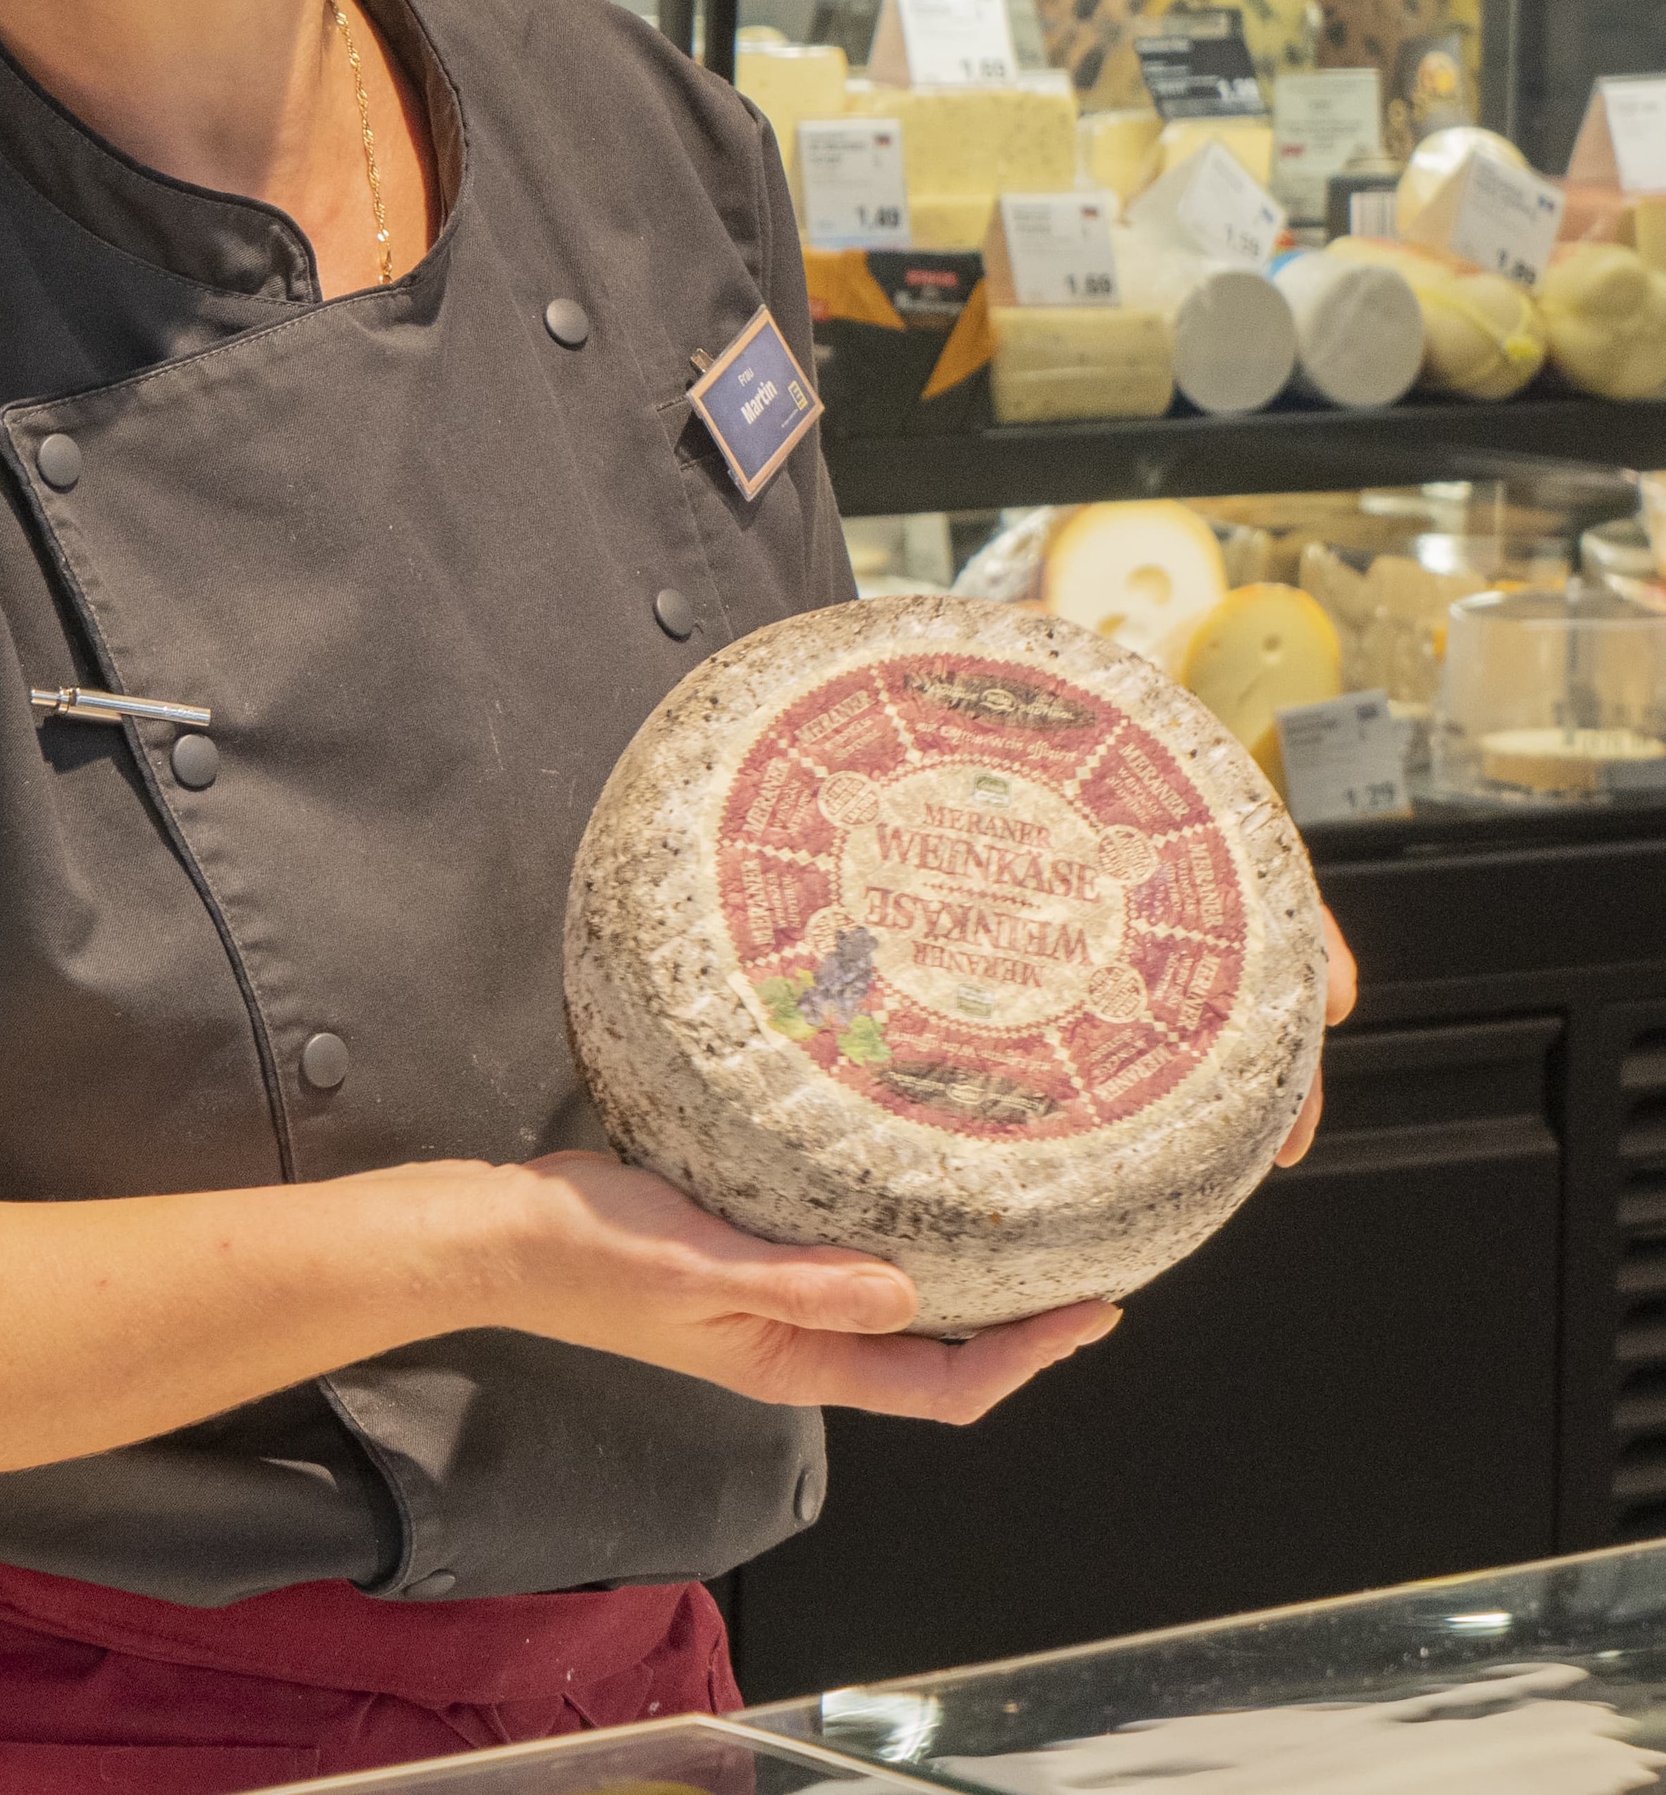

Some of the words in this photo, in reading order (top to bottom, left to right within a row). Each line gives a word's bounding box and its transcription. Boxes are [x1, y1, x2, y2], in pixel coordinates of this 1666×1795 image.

[737, 367, 754, 388] Frau
[740, 379, 779, 425] Martin
[742, 755, 792, 837] MERANER
[1111, 739, 1196, 822] MERANER
[876, 822, 1101, 904] WEINKÄSE
[924, 802, 1051, 849] MERANER
[1184, 840, 1226, 929] MERANER
[864, 885, 1094, 967] WEINKÄSE
[912, 940, 1046, 988] MERANER
